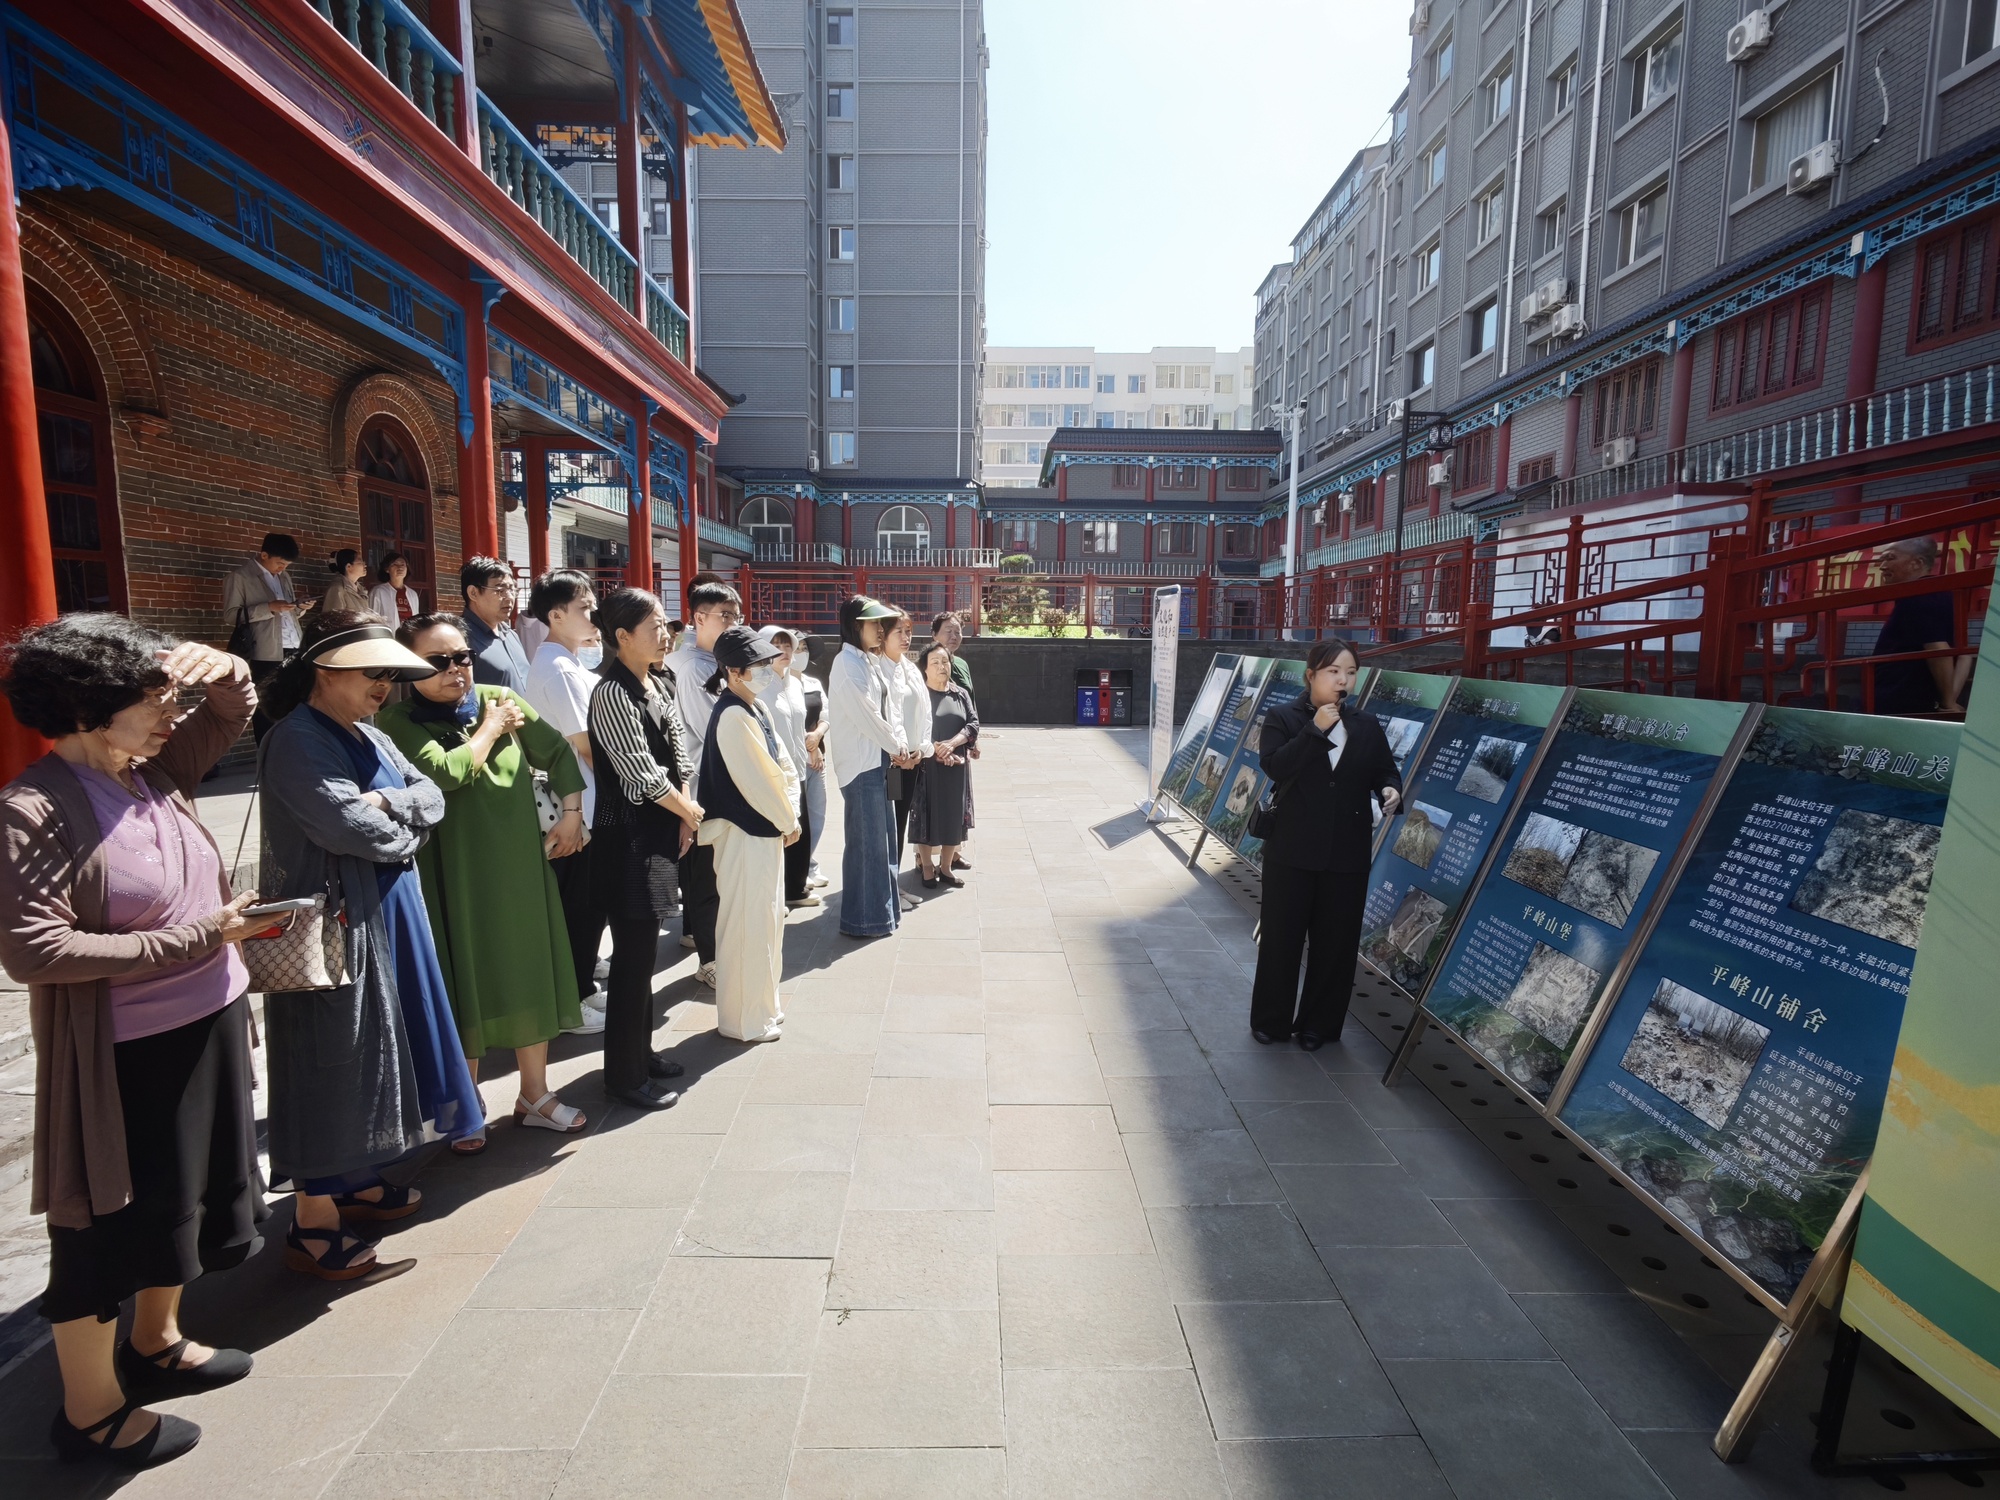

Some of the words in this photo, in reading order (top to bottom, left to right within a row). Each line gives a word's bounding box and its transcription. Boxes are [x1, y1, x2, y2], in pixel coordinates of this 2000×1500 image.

[1600, 713, 1689, 742] 平峰山烽火台
[1838, 744, 1951, 781] 平峰山关
[1750, 802, 1828, 827] 吉市依兰镇金达莱村
[1775, 794, 1835, 815] 平峰山关位于延
[1739, 825, 1814, 853] 平峰山关平面近长方
[1744, 814, 1815, 839] 西北约2700米处。
[1719, 861, 1792, 890] 央设有一条宽约4米
[1521, 903, 1573, 942] 平峰山堡
[1709, 963, 1828, 1034] 平峰山铺舍
[1768, 1050, 1857, 1102] 延吉市依兰镇利民村
[1796, 1045, 1864, 1086] 平峰山铺舍位于
[1749, 1089, 1833, 1146] 铺舍形制清晰，为毛
[1755, 1076, 1841, 1131] 3000米处。平峰山
[1734, 1115, 1818, 1174] 形。西侧墙体南端有
